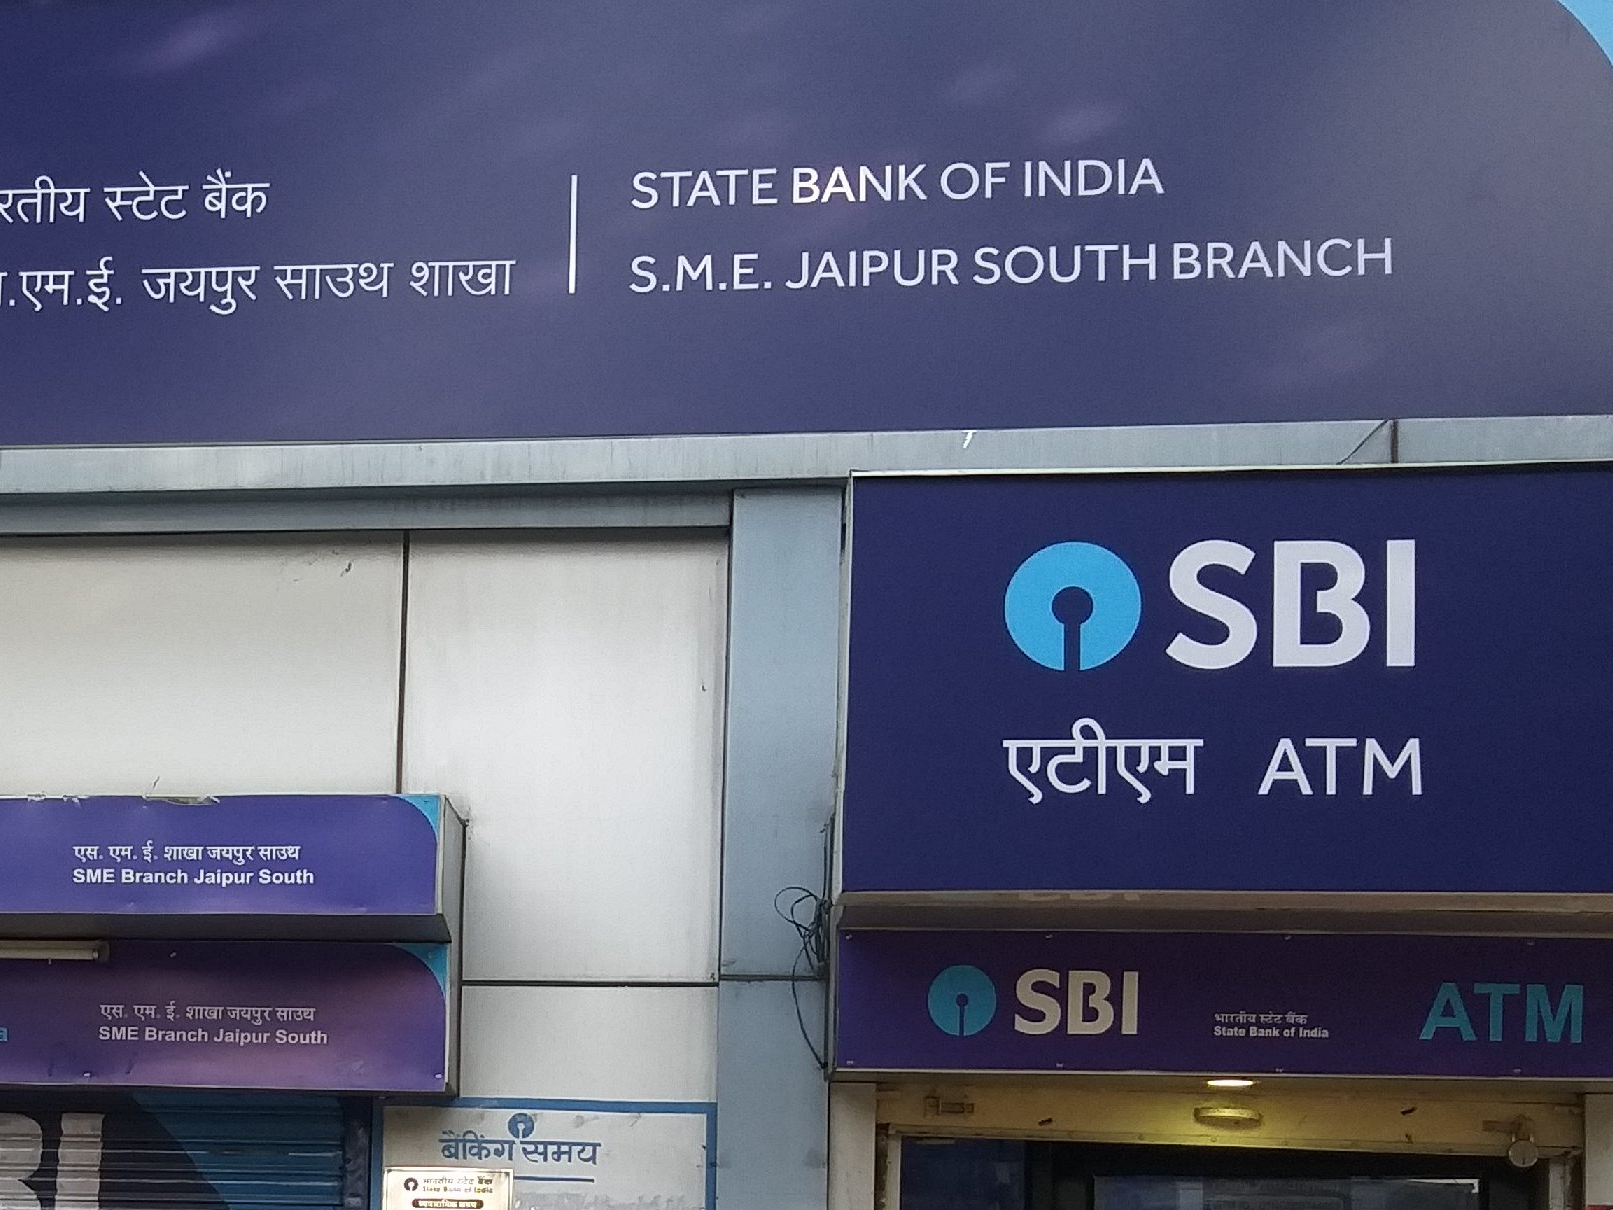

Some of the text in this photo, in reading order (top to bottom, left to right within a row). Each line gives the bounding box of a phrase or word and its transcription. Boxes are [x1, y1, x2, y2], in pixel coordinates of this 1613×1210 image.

[104, 171, 189, 221] स्टेट
[202, 168, 270, 218] बैंक
[632, 158, 1164, 209] STATE BANK OF INDIA
[142, 266, 260, 315] जयपुर
[274, 262, 394, 300] साउथ
[409, 260, 516, 297] शाखा
[629, 237, 1392, 293] S.M.E. JAIPUR SOUTH BRANCH
[1165, 539, 1417, 670] SBI
[1003, 718, 1204, 804] एटीएम
[1258, 737, 1422, 796] ATM
[72, 868, 315, 887] SME Branch Jaipur South
[73, 840, 302, 865] एस. एम. ई. शाखा जयपुर साउथ
[100, 1004, 129, 1020] एस.
[133, 1004, 161, 1021] एम.
[185, 1006, 224, 1021] शाखा
[227, 1007, 271, 1026] जयपुर
[276, 1007, 316, 1021] साउथ
[1014, 969, 1140, 1036] SBI
[1215, 1011, 1257, 1024] भारतीय
[1259, 1011, 1283, 1024] स्टेट
[1419, 982, 1584, 1044] ATM
[99, 1026, 328, 1046] SME Branch Jaipur South
[1214, 1026, 1329, 1038] State Bank of India
[519, 1140, 602, 1165] समय
